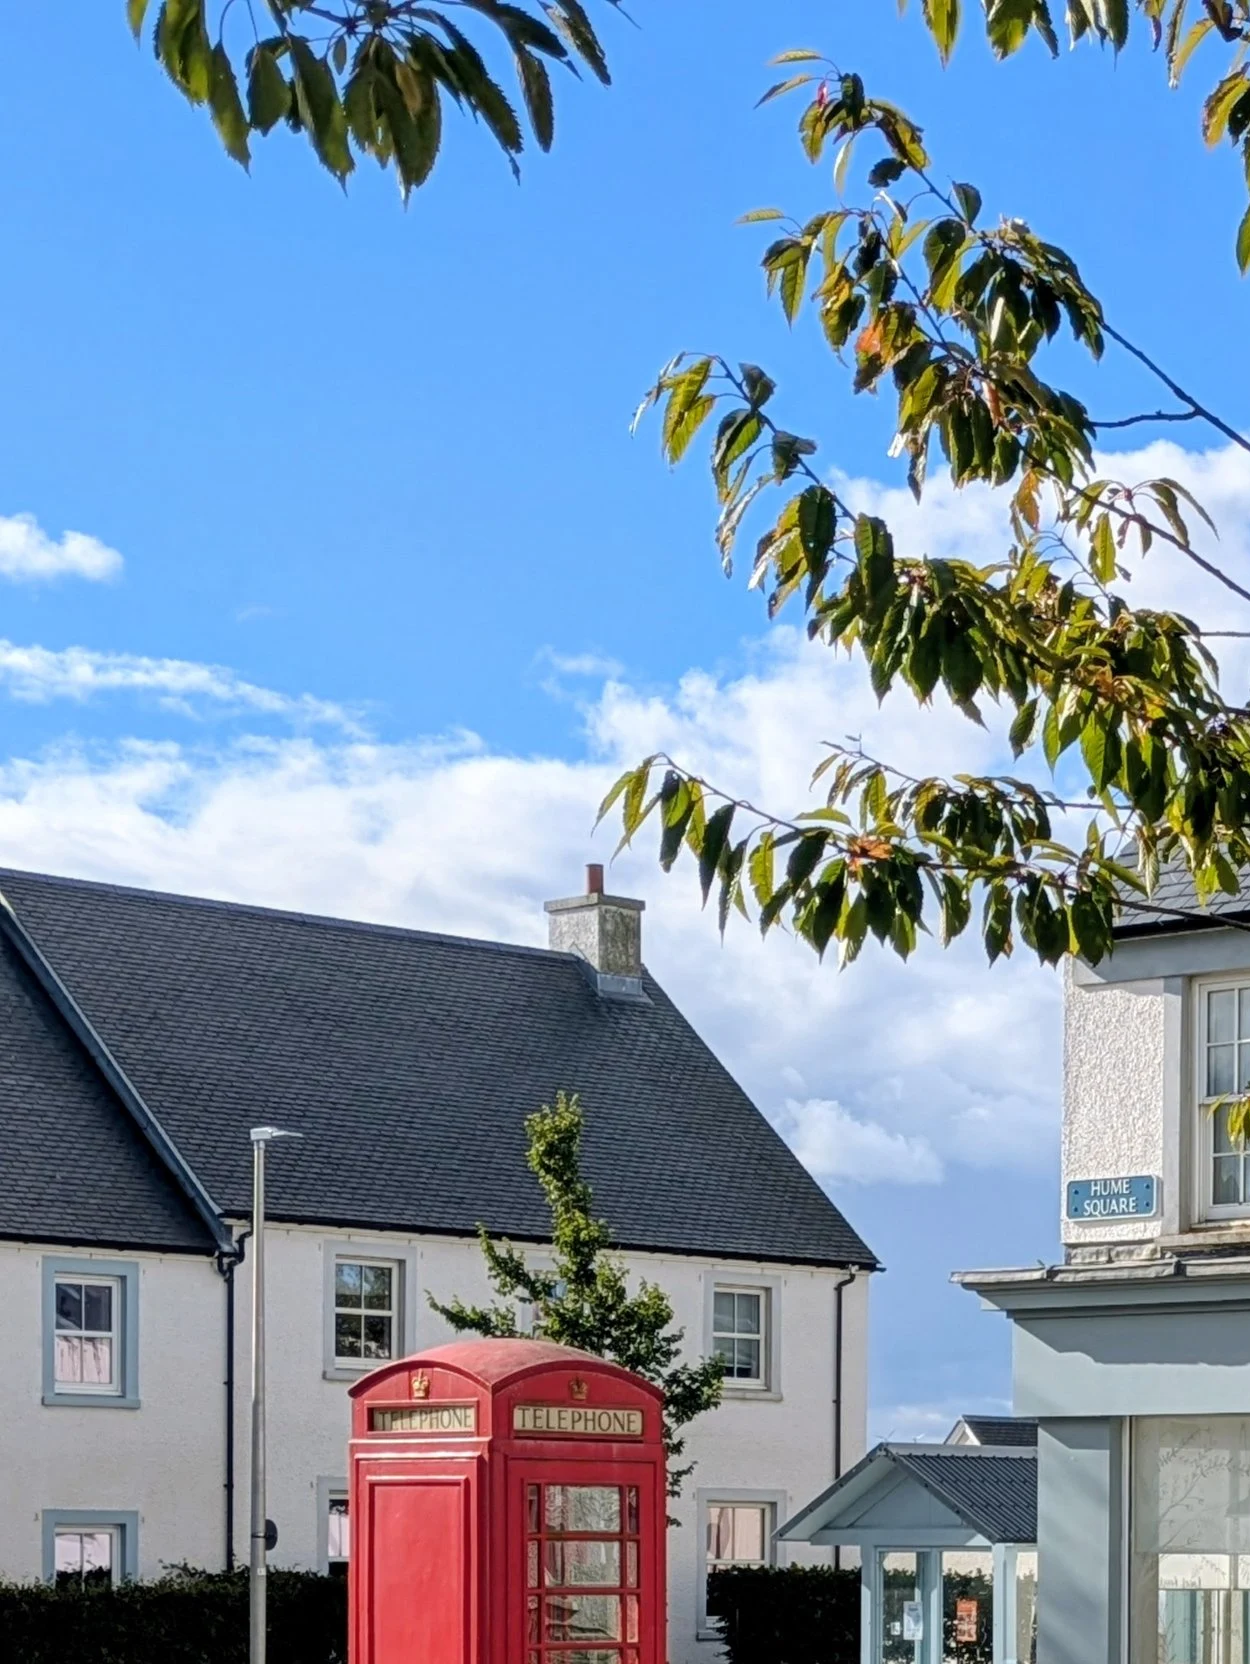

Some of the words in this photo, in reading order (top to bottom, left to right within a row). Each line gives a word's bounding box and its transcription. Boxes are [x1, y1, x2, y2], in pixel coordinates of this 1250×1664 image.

[1091, 1179, 1130, 1196] HUME
[1083, 1197, 1137, 1217] SQUARE
[378, 1406, 473, 1432] TELEPHONE
[517, 1407, 638, 1433] TELEPHONE
